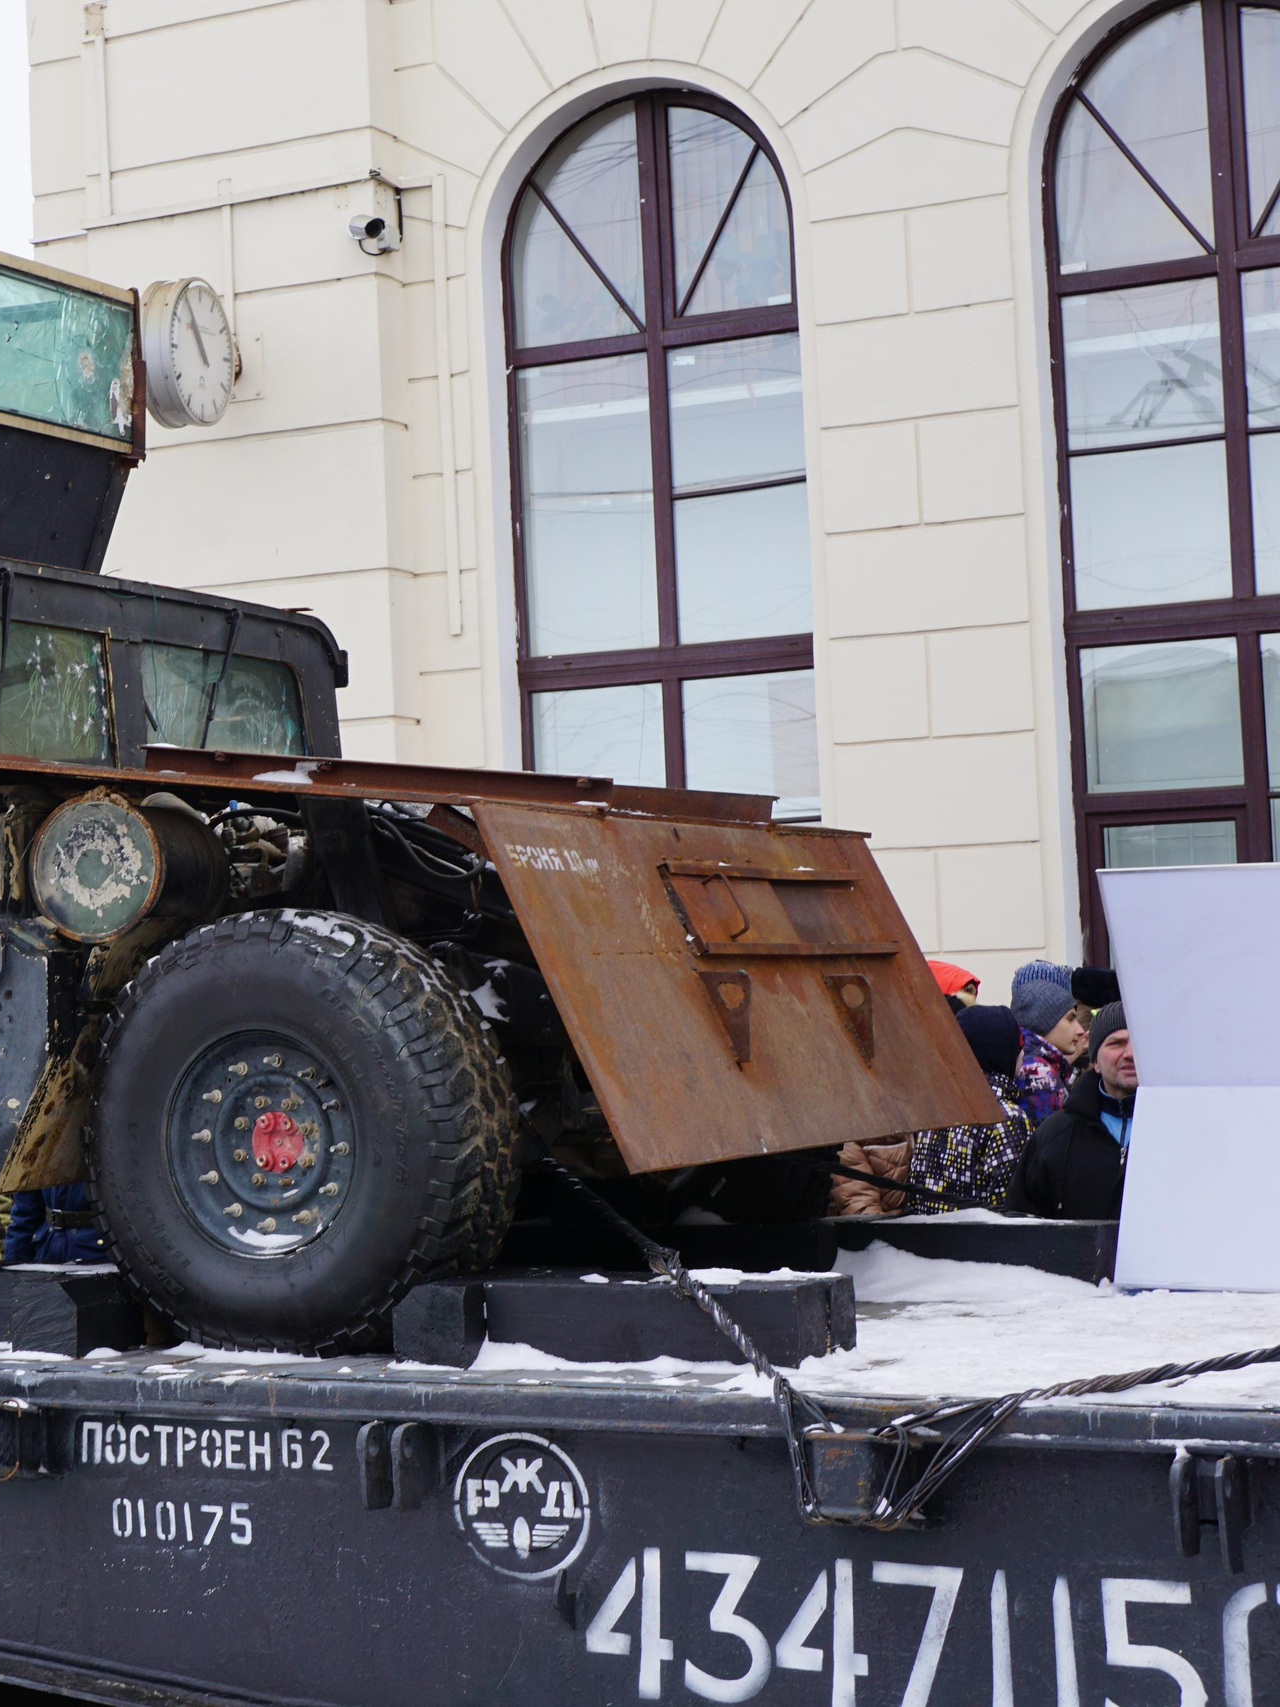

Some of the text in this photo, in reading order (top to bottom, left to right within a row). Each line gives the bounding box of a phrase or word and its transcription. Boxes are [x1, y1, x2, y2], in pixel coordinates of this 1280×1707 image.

[504, 843, 565, 871] БРОНЯ
[81, 1421, 271, 1471] ПОСТРОЕН
[466, 1456, 582, 1519] РЖД
